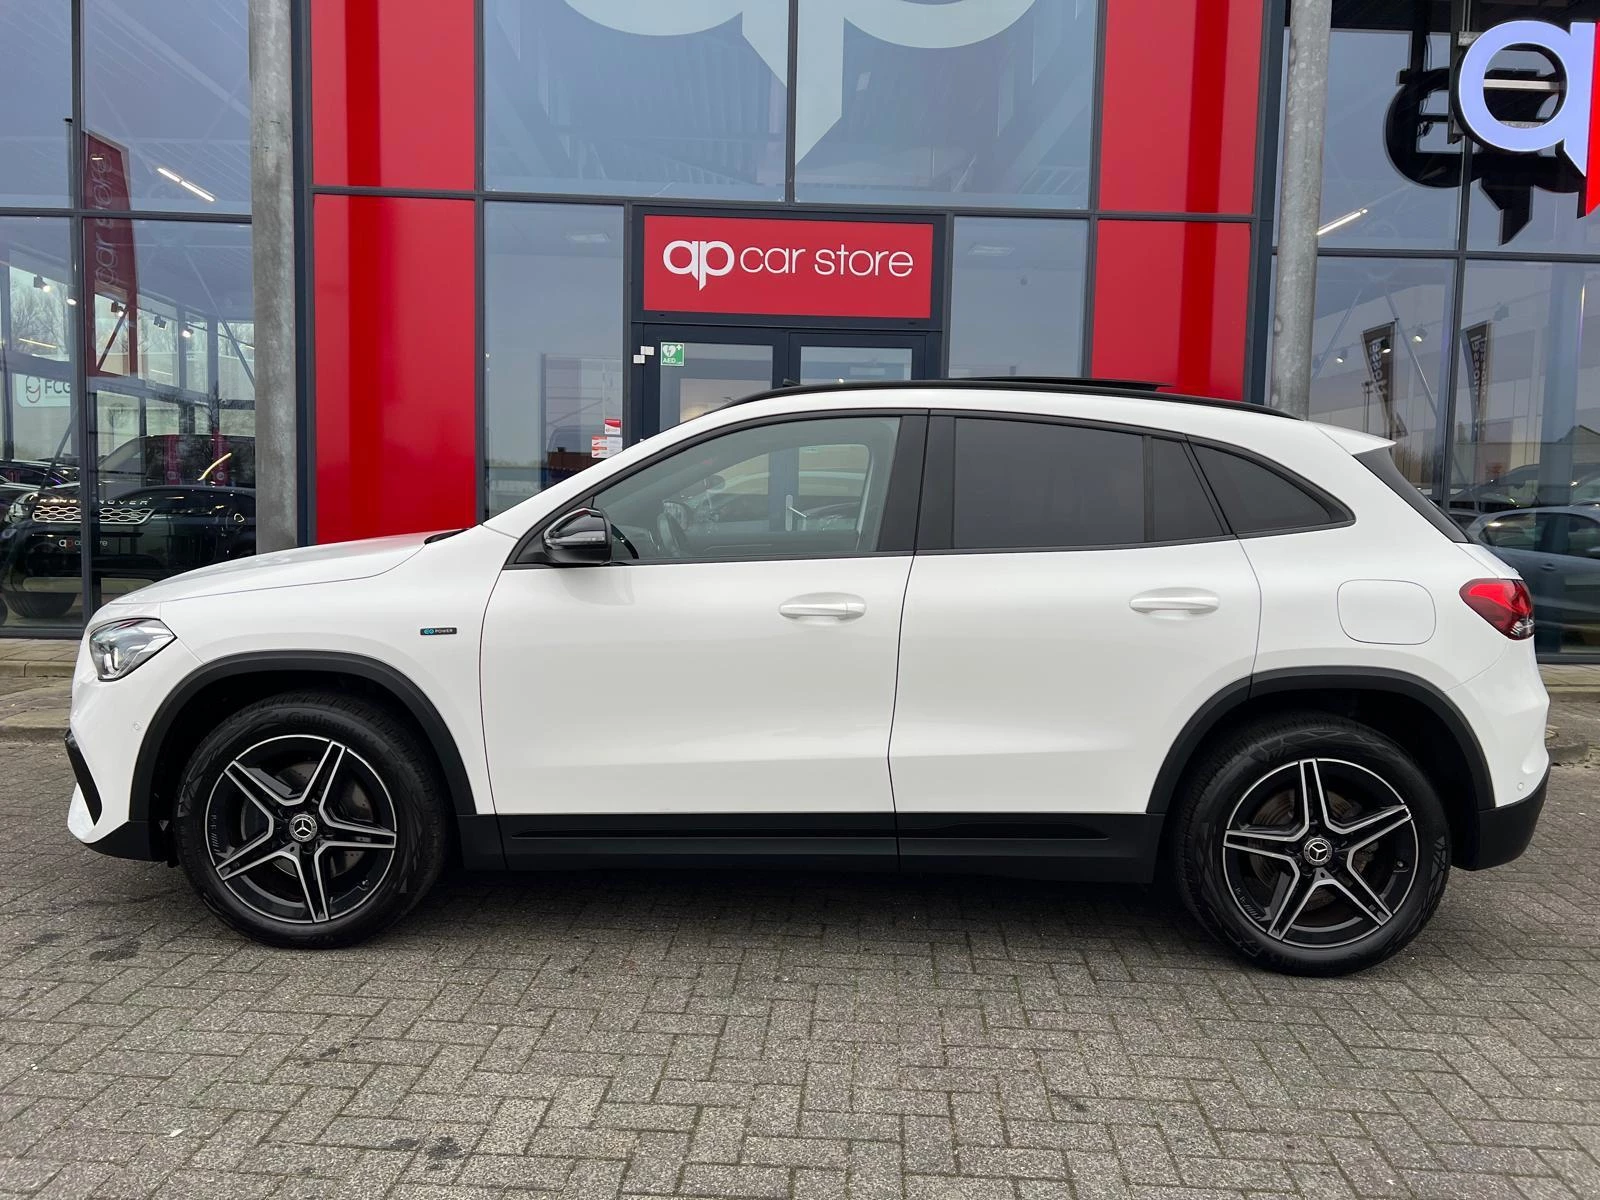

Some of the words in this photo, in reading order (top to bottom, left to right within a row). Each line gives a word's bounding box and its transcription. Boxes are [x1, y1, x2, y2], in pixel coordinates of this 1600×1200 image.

[1459, 20, 1600, 216] a
[663, 240, 735, 291] ap
[740, 247, 806, 274] car
[814, 244, 914, 277] store
